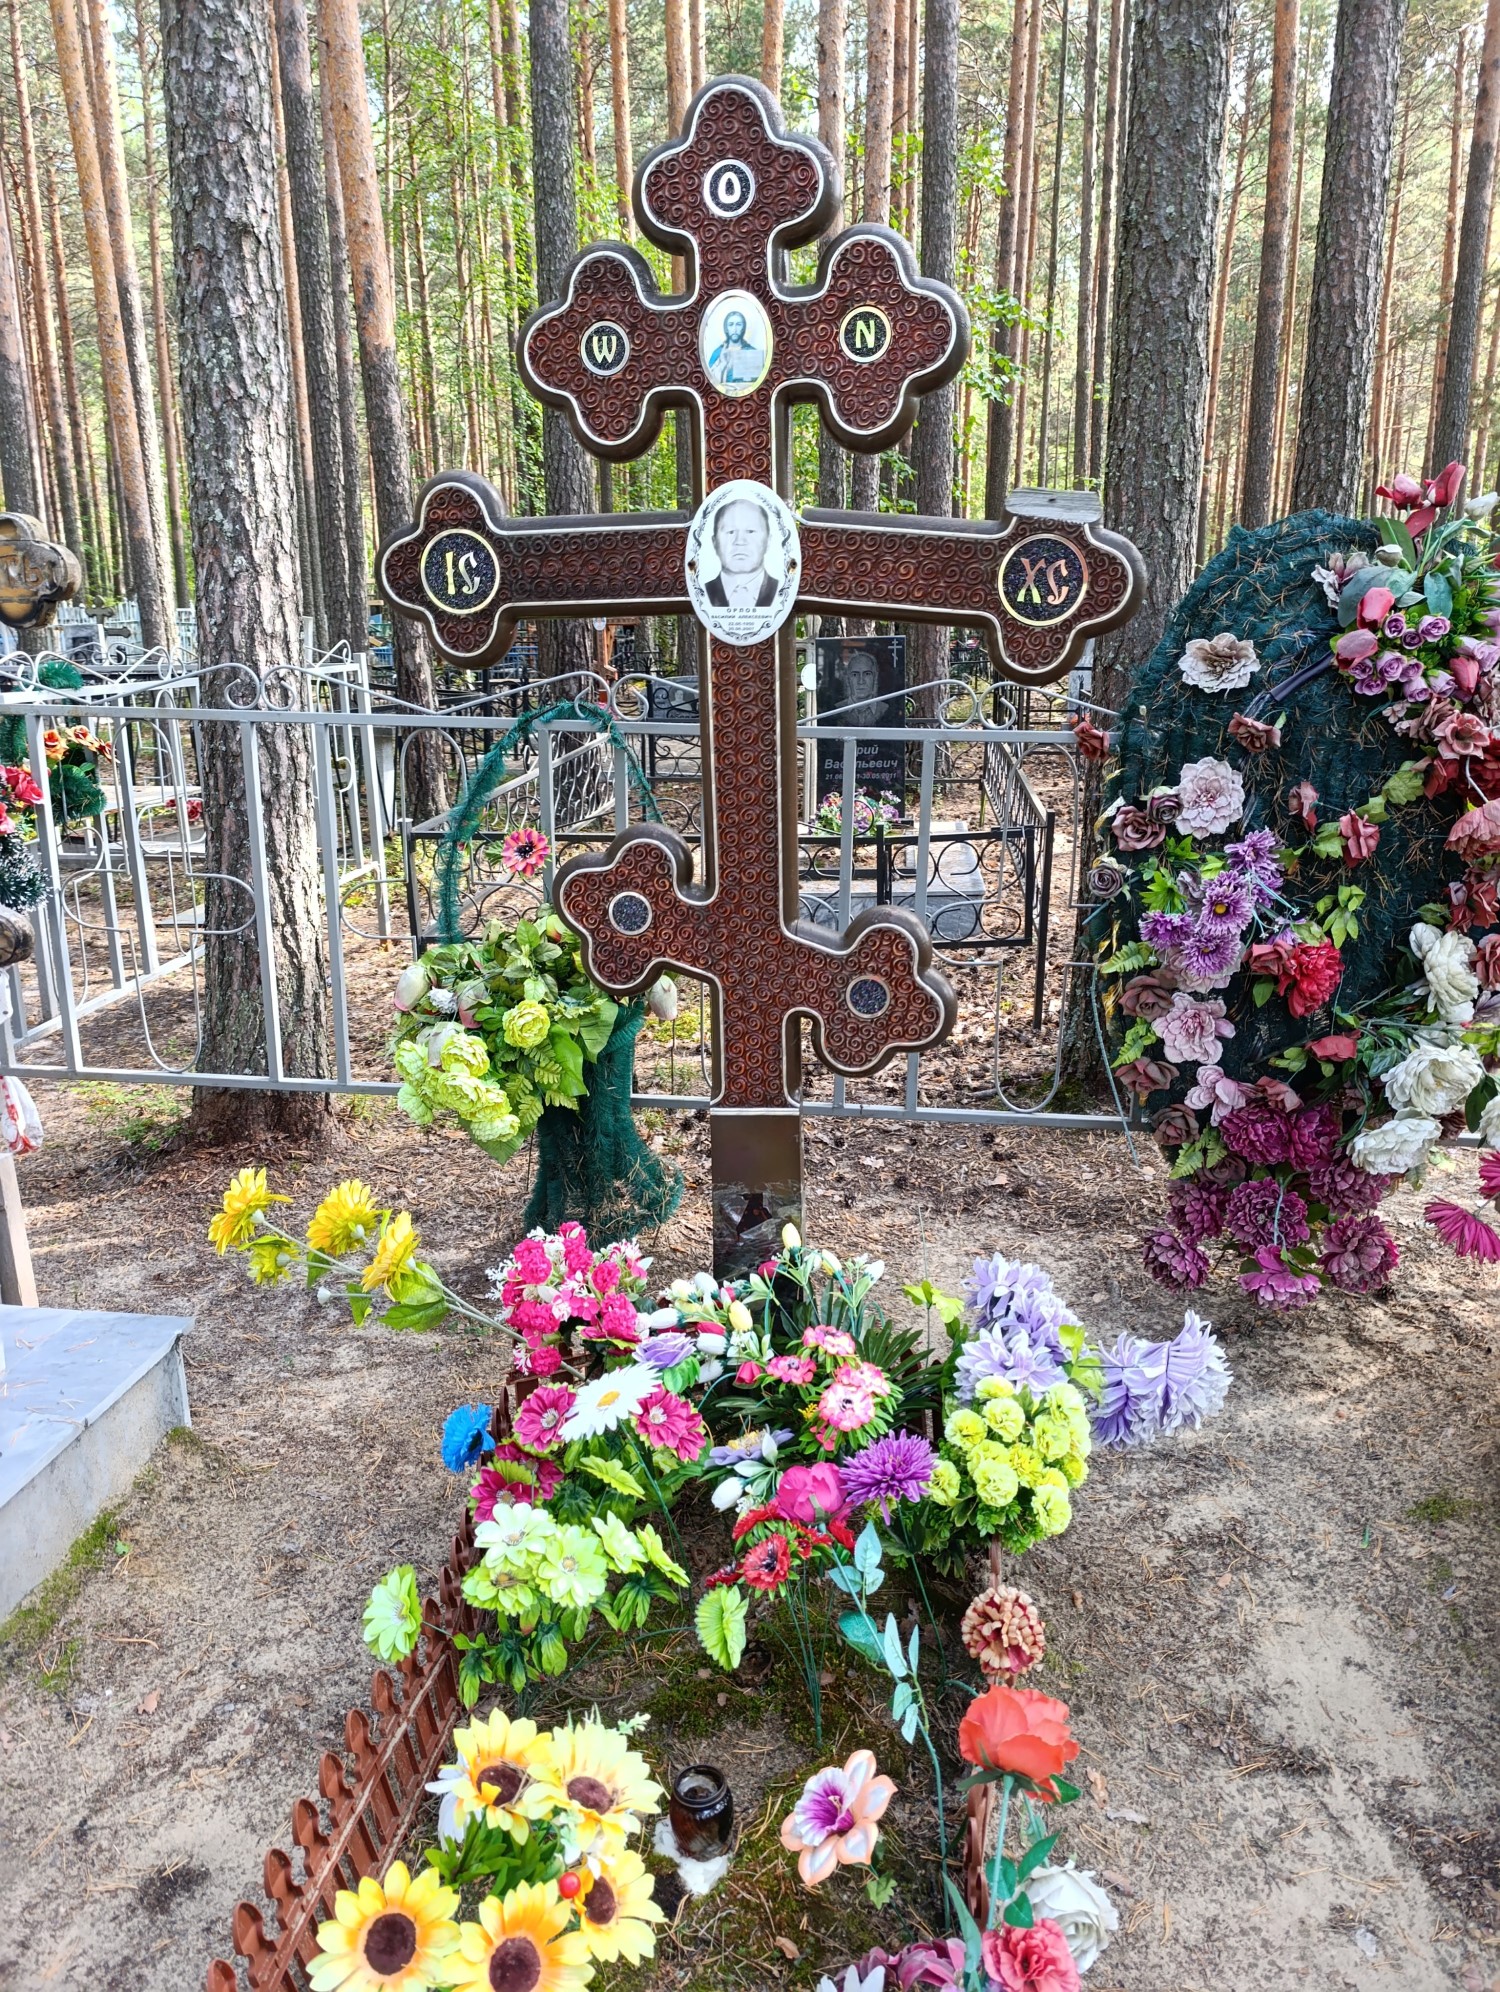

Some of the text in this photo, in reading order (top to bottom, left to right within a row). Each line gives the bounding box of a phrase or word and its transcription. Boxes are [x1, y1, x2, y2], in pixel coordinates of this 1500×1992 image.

[855, 320, 876, 349] N
[853, 744, 880, 757] рий
[824, 758, 898, 769] Васльевич
